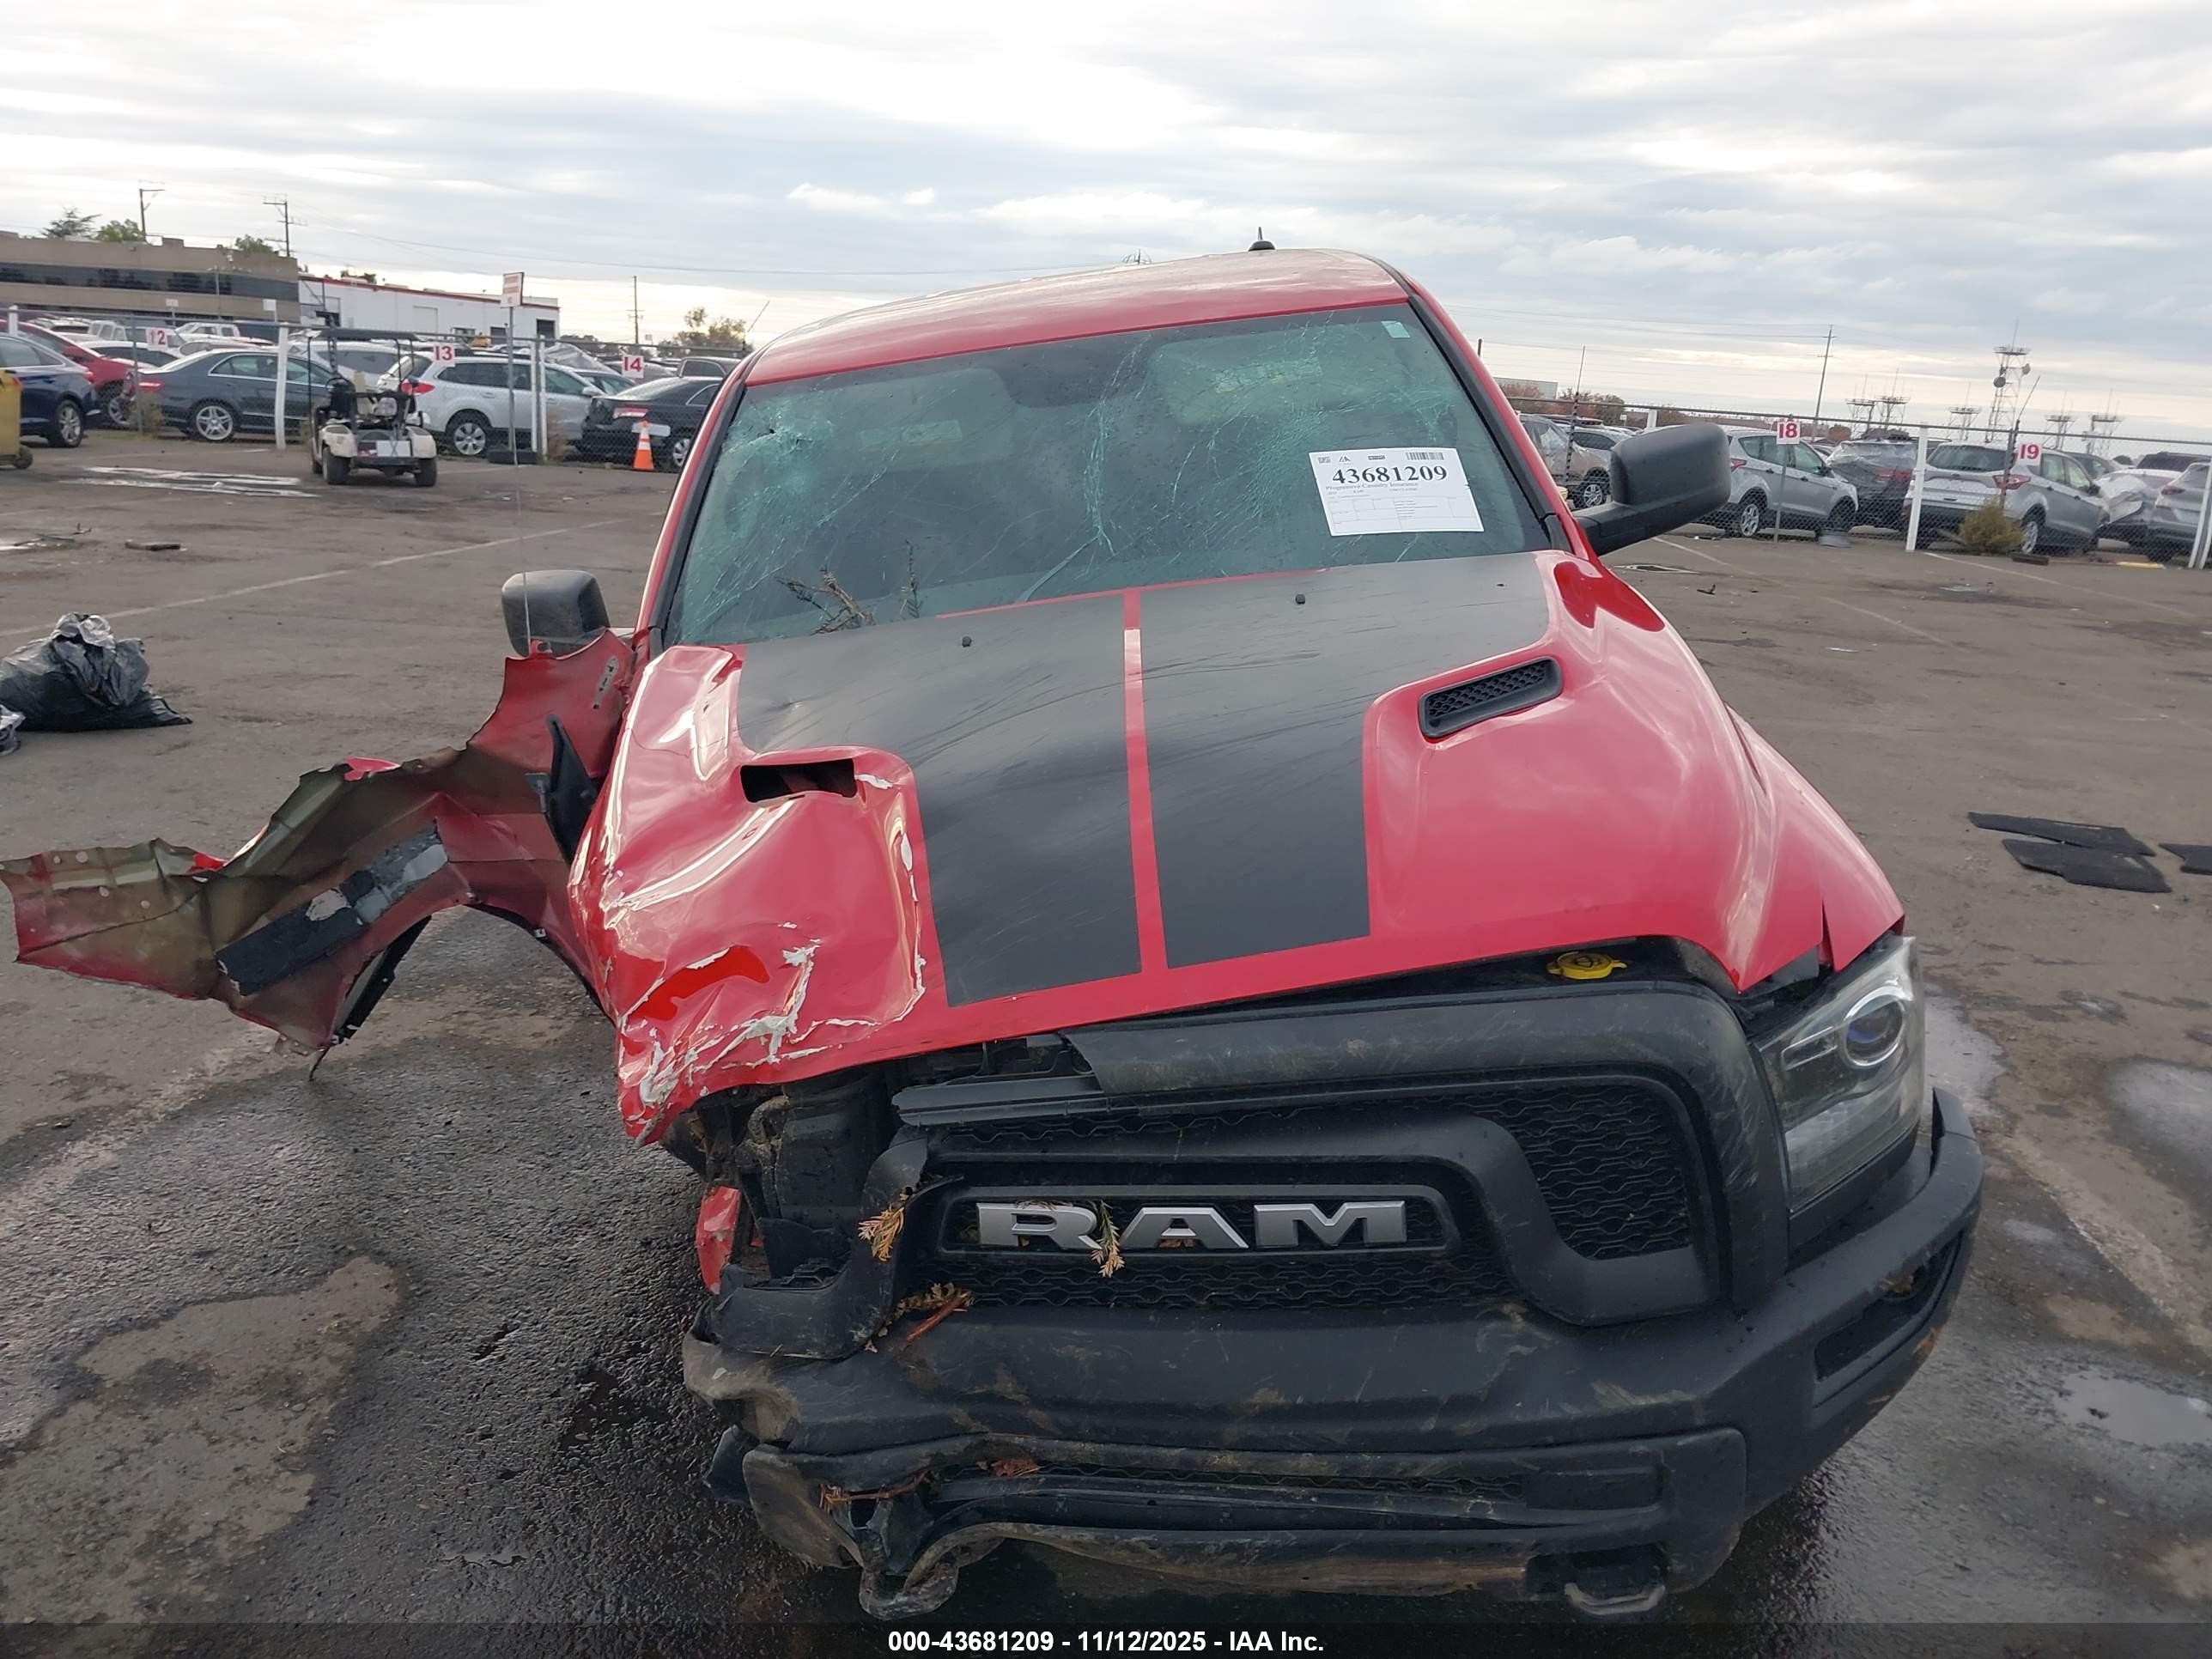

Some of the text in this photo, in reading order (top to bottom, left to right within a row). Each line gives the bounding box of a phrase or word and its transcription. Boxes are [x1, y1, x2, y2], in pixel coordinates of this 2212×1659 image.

[149, 331, 166, 345] 12
[434, 345, 453, 362] 13
[623, 356, 641, 372] 14
[1778, 422, 1798, 439] 18
[2020, 444, 2040, 459] 19
[1332, 465, 1448, 484] 43681209
[976, 1200, 1407, 1251] RAM
